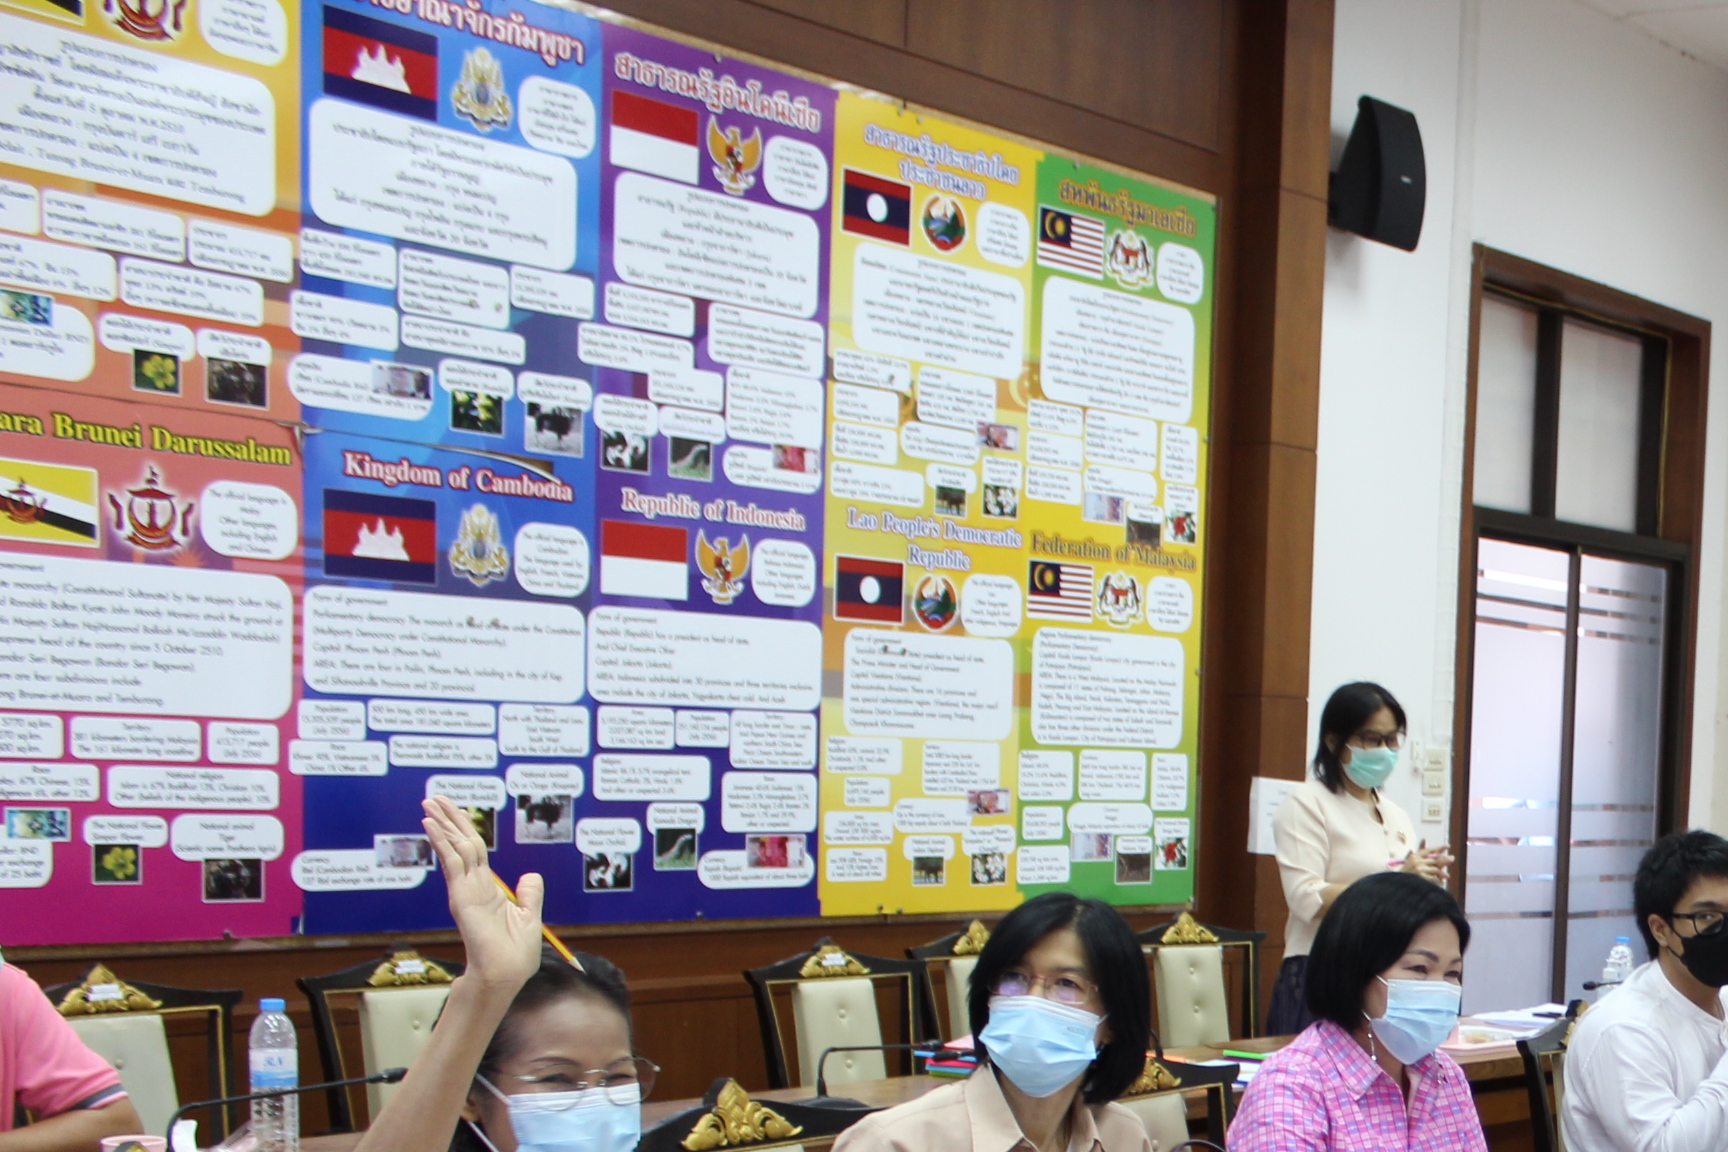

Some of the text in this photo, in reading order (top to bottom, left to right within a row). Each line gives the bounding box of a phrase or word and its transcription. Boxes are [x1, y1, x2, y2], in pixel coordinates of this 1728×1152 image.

[358, 0, 585, 67] อาณาจักรกัมพูชา
[52, 412, 143, 449] Brunei
[149, 425, 292, 465] Darussalam
[343, 450, 574, 503] Kingdom of Cambodia
[621, 487, 806, 532] Republic of Indonesia
[847, 507, 1022, 548] Lao People's Democratic
[908, 545, 971, 571] Republic
[1031, 532, 1196, 573] Federation of Malaysia
